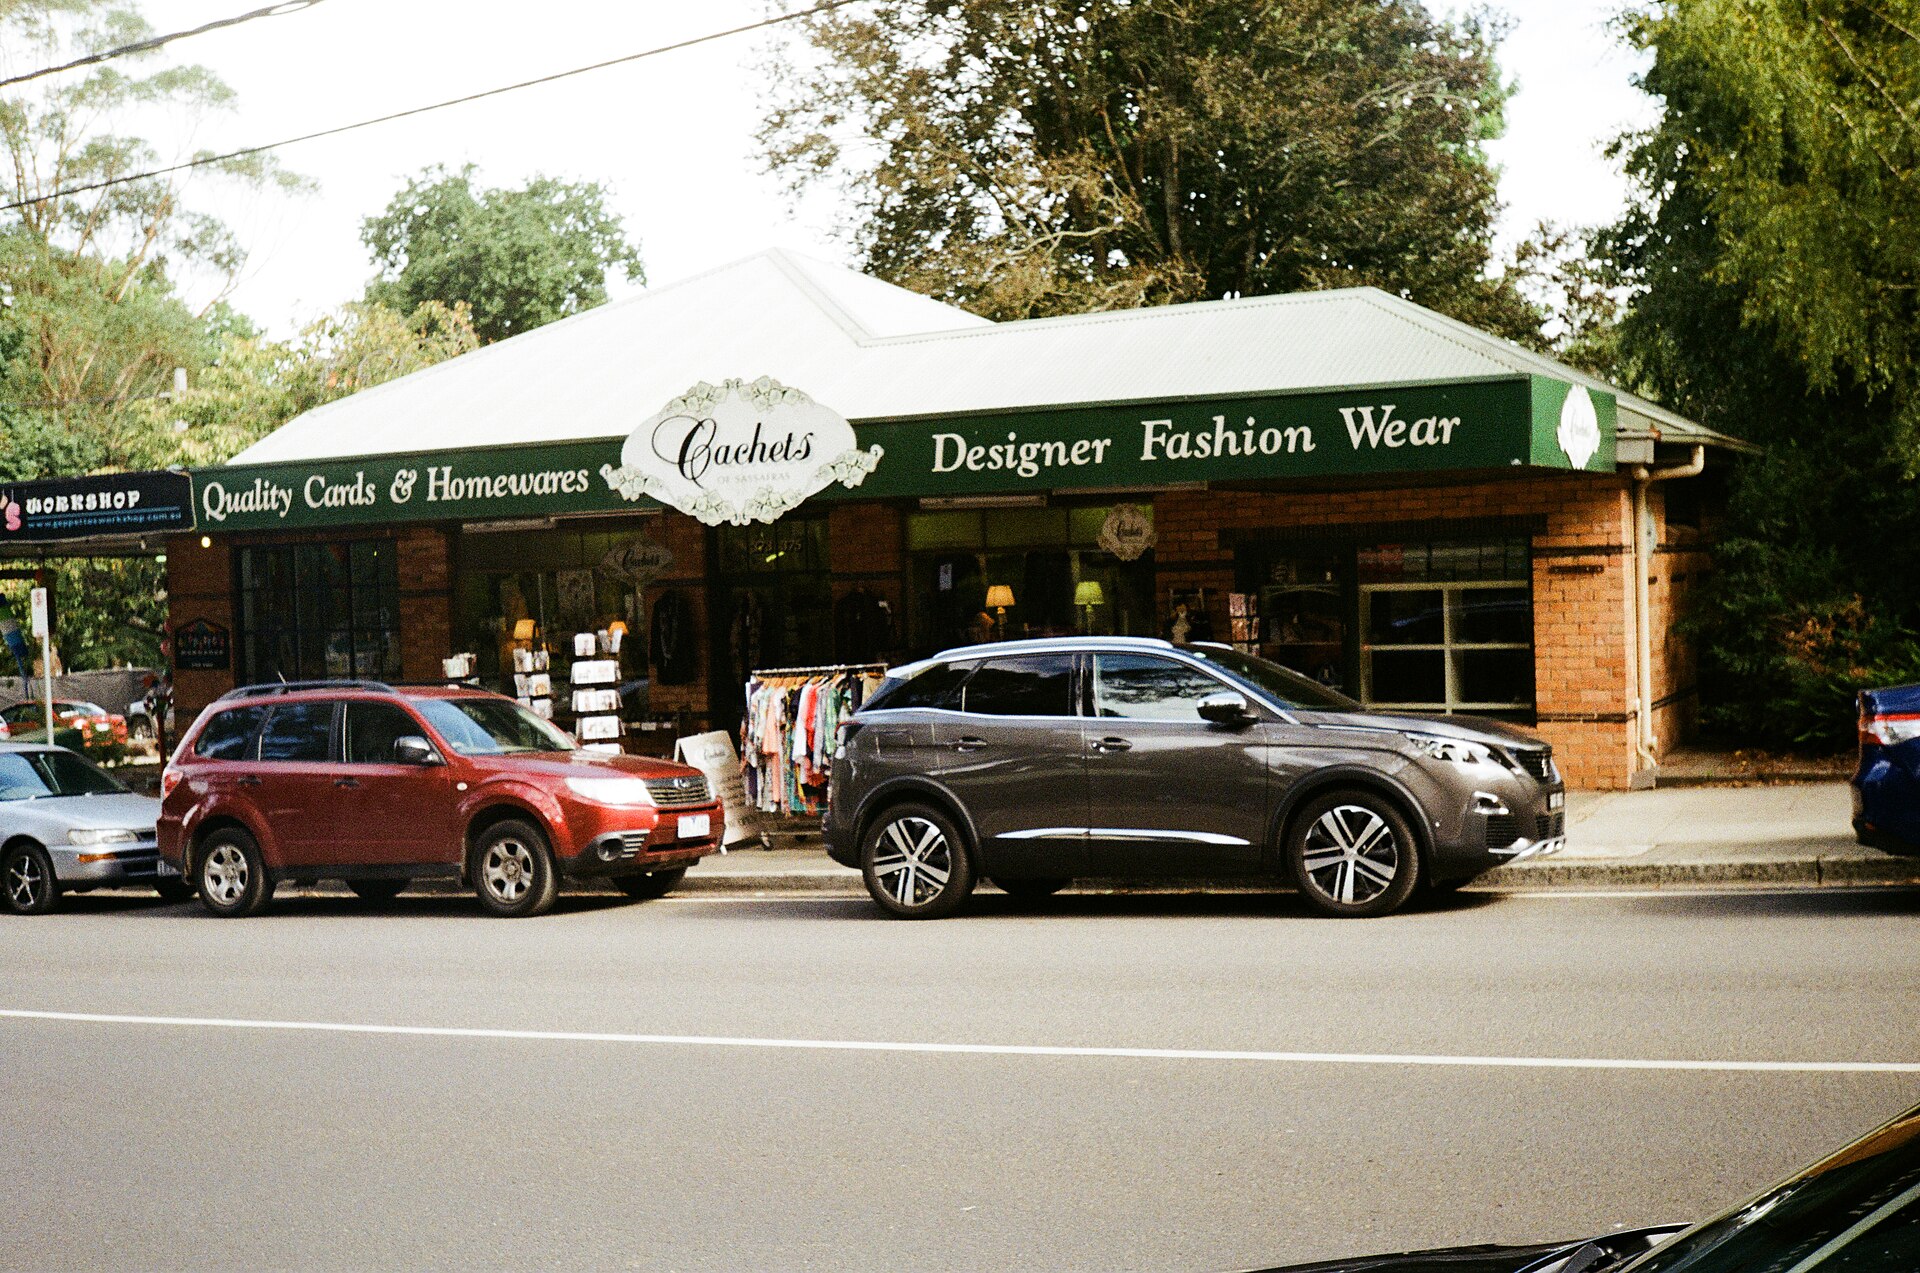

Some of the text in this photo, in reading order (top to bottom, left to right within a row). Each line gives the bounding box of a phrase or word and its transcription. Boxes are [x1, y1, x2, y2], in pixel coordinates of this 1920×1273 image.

[651, 414, 814, 489] Cachets
[931, 404, 1461, 478] Designer Fashion Wear
[25, 490, 141, 515] WORKSHOP
[202, 465, 589, 522] Quality Cards & Homewares
